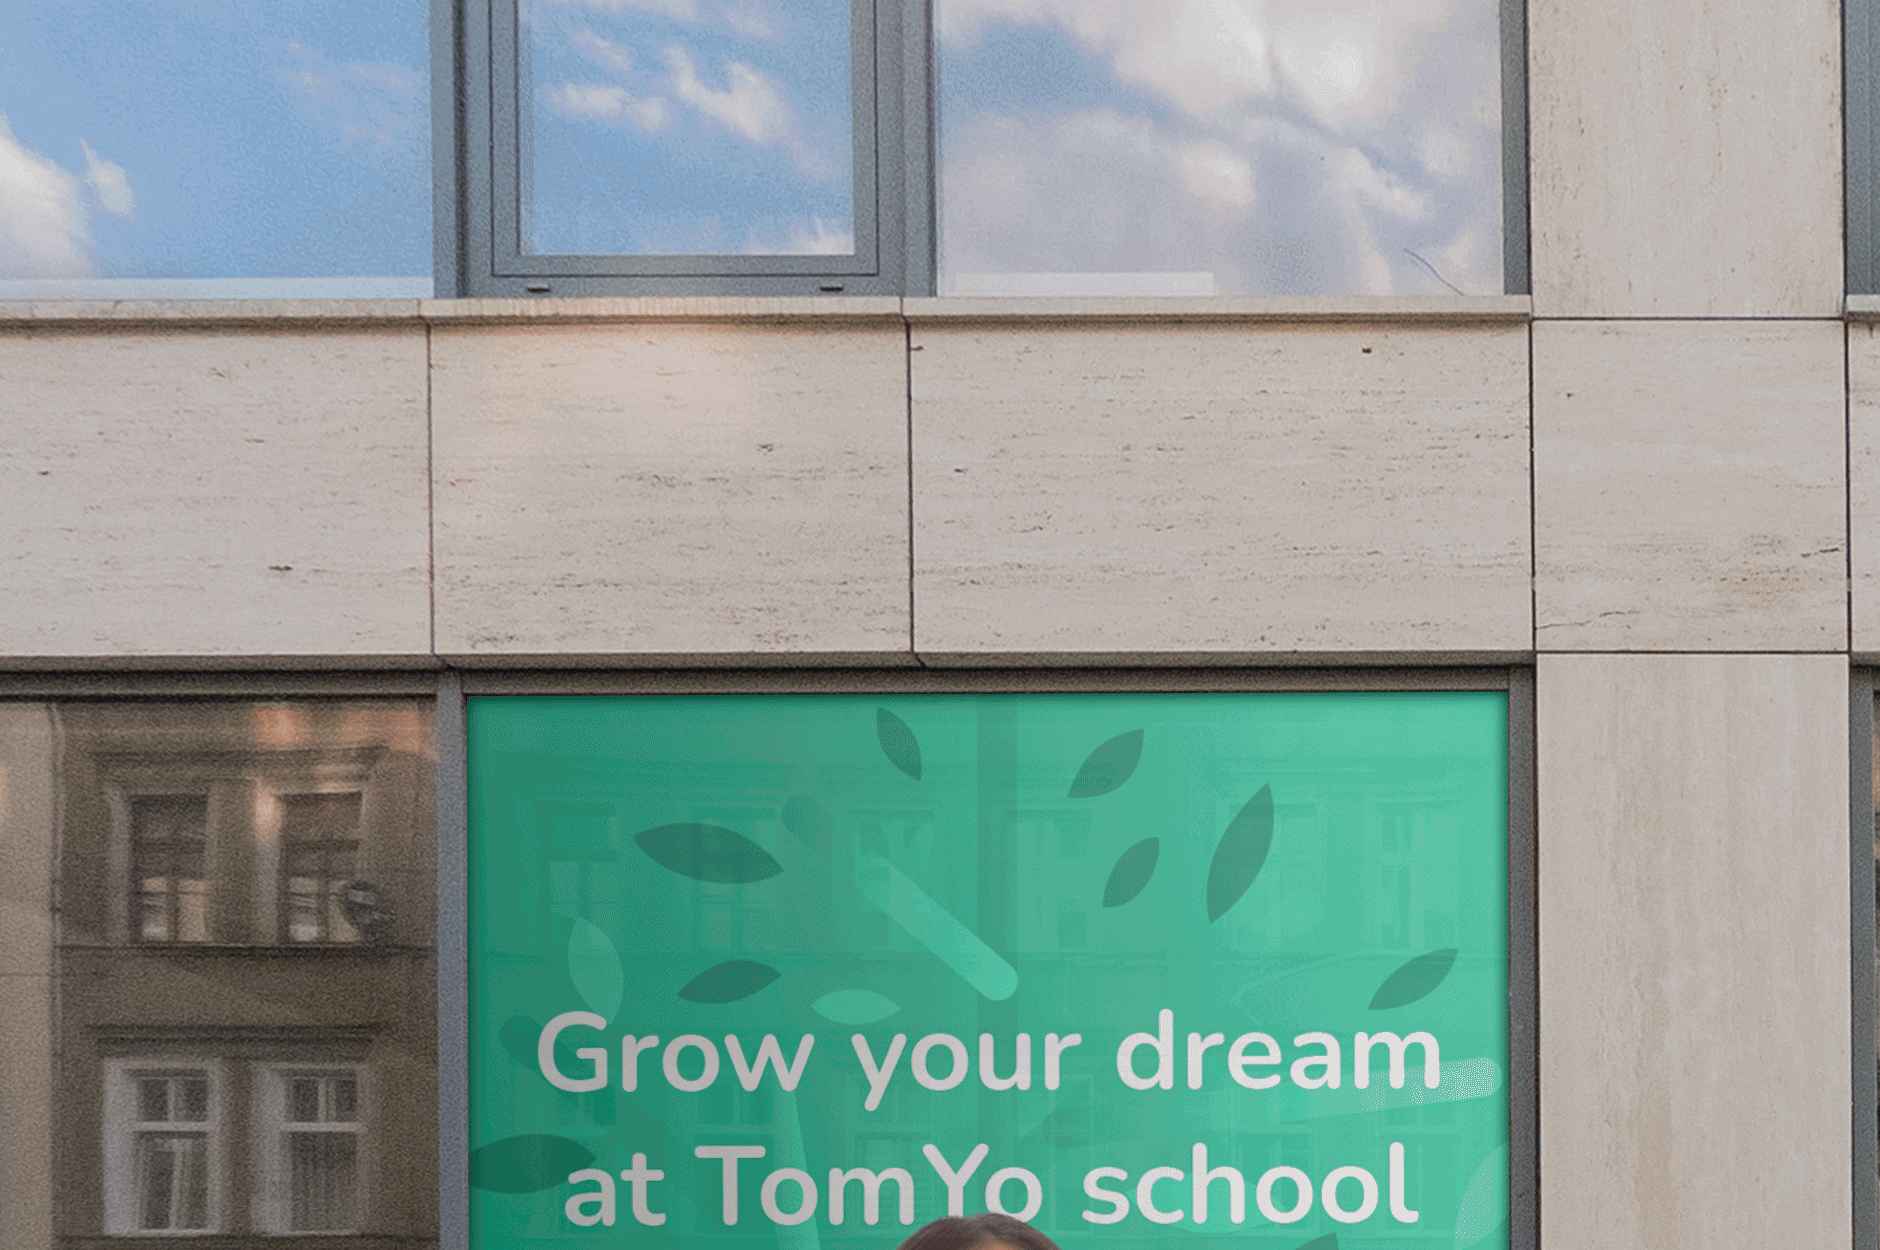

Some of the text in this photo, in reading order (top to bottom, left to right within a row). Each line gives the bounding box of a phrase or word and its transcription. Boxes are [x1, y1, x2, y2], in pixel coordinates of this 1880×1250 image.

[538, 1008, 1442, 1112] Grow your dream
[565, 1142, 1420, 1227] at TomYo school
